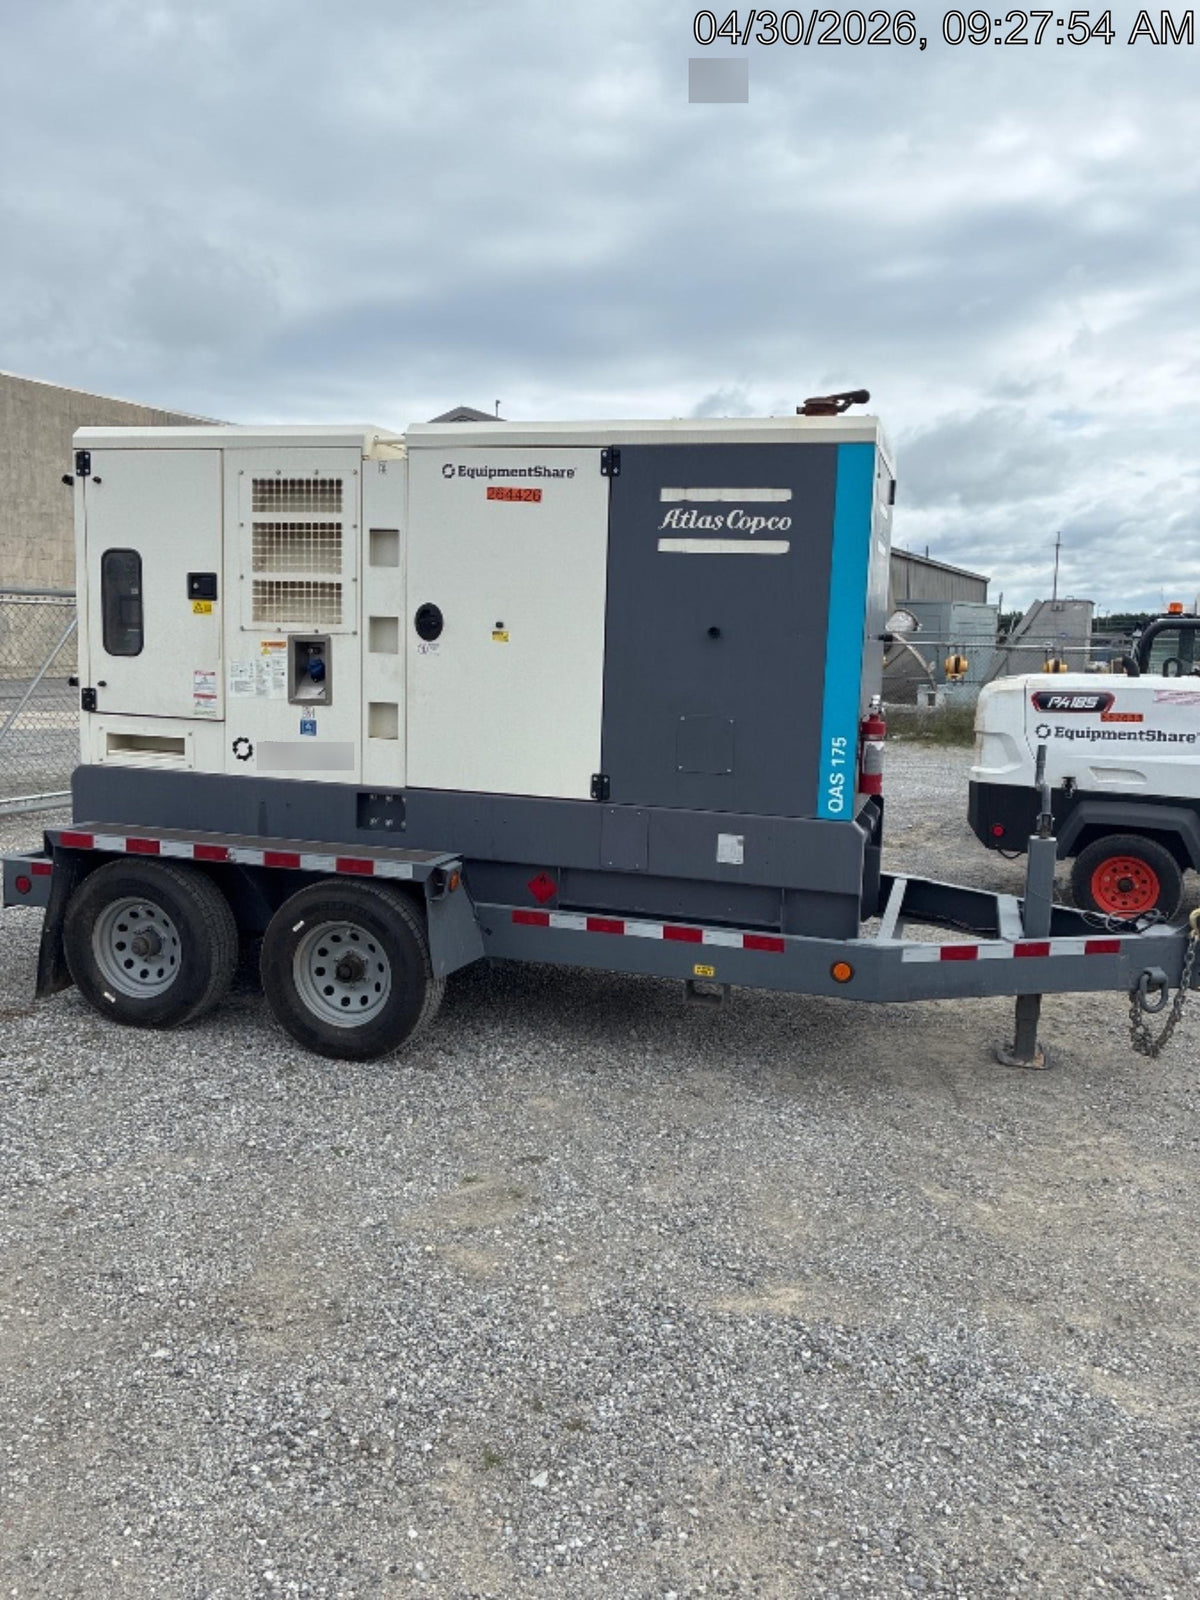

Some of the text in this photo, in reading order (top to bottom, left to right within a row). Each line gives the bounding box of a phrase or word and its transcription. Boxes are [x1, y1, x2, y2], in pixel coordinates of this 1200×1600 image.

[458, 465, 575, 480] EquipmentShare
[487, 488, 541, 501] 264426
[658, 508, 793, 534] Atlas Copco
[1054, 726, 1197, 744] EquipmentShare
[828, 737, 847, 813] QAS 175
